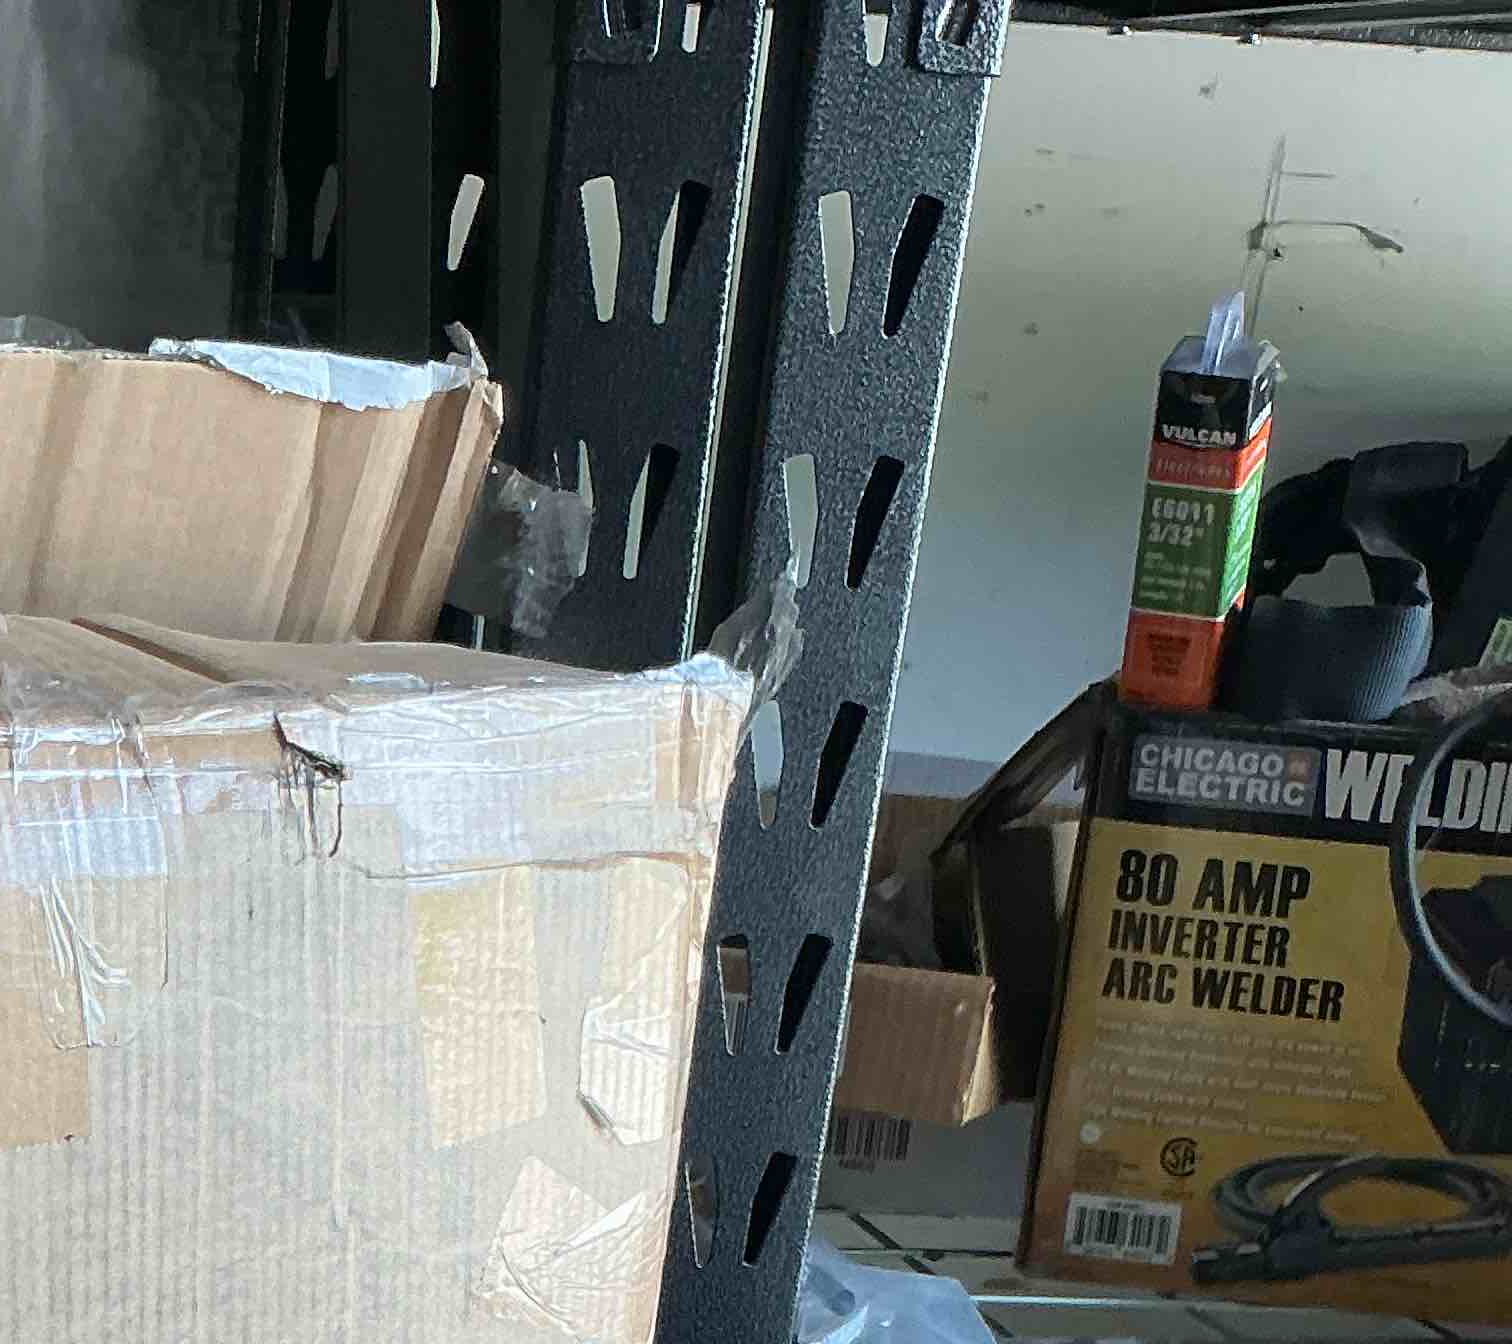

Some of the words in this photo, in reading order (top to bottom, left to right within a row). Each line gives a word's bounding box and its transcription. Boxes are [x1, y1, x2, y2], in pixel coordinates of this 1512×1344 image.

[1135, 768, 1306, 807] ELECTRIC
[1140, 743, 1285, 778] CHICAGO
[1116, 849, 1179, 907] 80
[1191, 858, 1312, 919] AMP
[1107, 908, 1291, 969] INVERTER
[1101, 957, 1178, 1005] ARC
[1191, 966, 1346, 1022] WELDER
